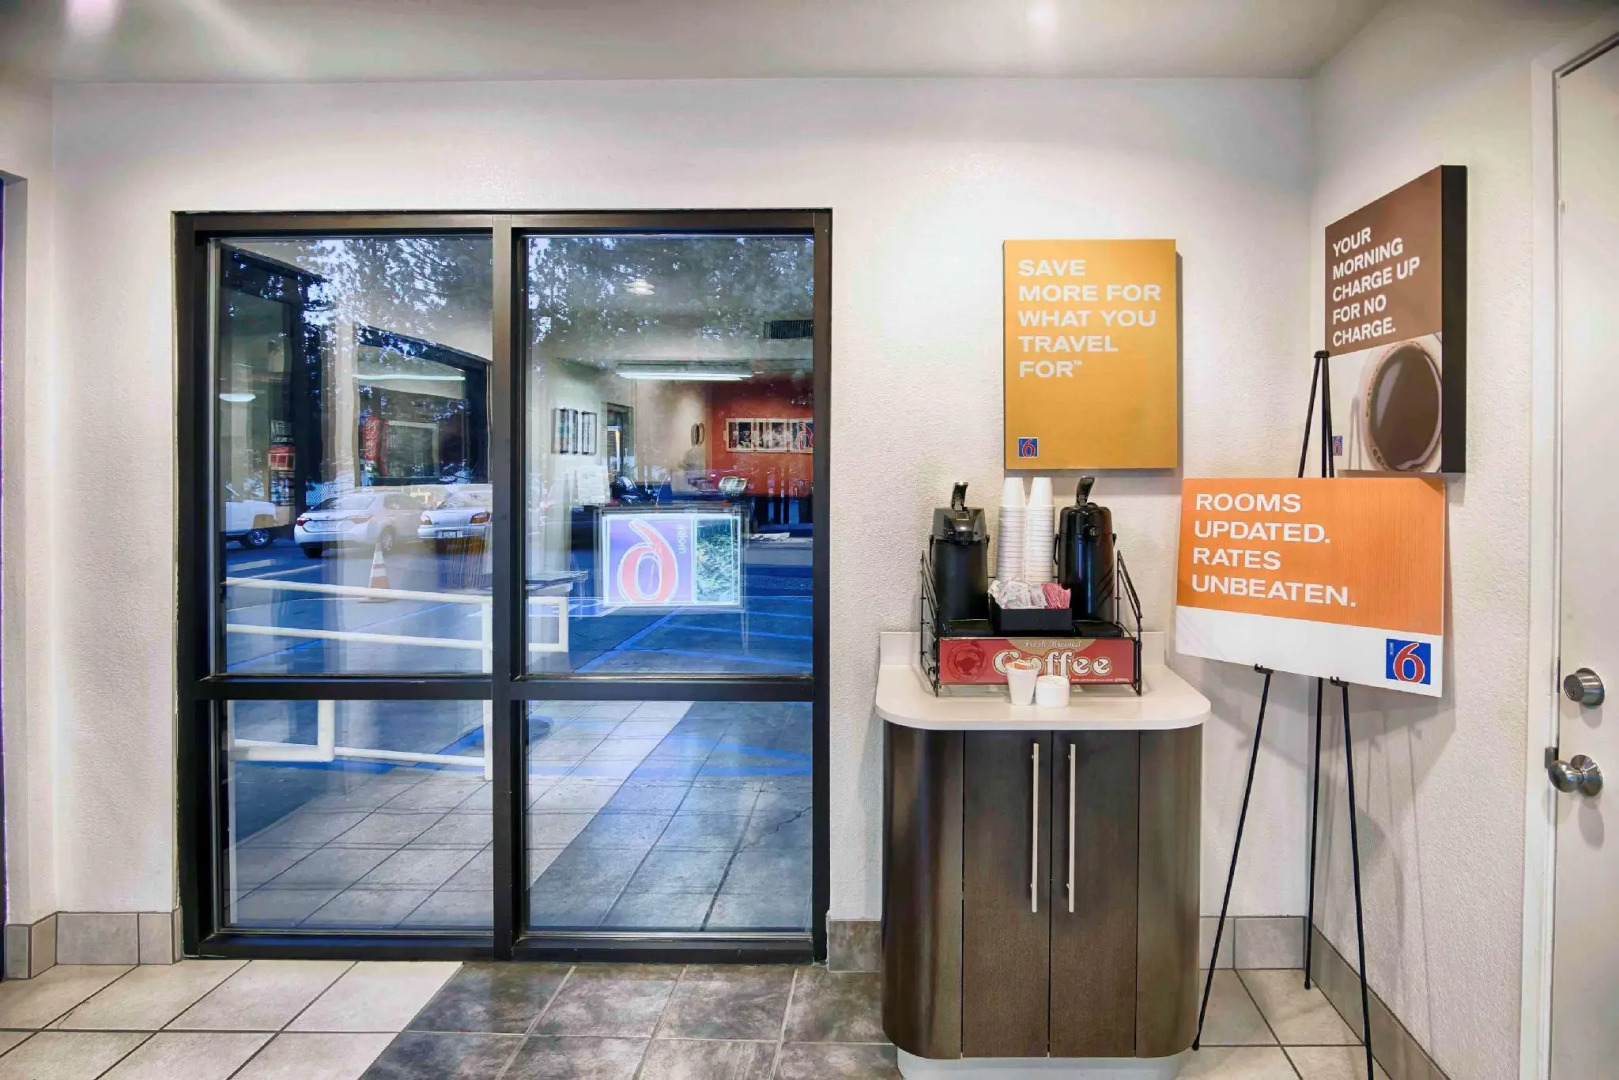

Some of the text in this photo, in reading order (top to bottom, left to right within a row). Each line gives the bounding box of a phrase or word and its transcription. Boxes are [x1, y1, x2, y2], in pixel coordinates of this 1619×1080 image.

[1332, 227, 1371, 258] YOUR
[1018, 259, 1086, 277] SAVE
[1332, 237, 1403, 280] MORNING
[1332, 256, 1420, 302] CHARGE UP
[1018, 284, 1161, 302] MORE FOR
[1018, 310, 1157, 327] WHAT YOU
[1332, 294, 1387, 325] FOR NO
[1018, 335, 1119, 352] TRAVEL
[1332, 317, 1396, 347] CHARGE.
[1022, 439, 1036, 458] 6
[1195, 493, 1302, 513] ROOMS
[1194, 520, 1331, 544] UPDATED.
[1193, 547, 1281, 570] RATES
[1192, 574, 1356, 607] UNBEATEN.
[1393, 642, 1426, 683] 6
